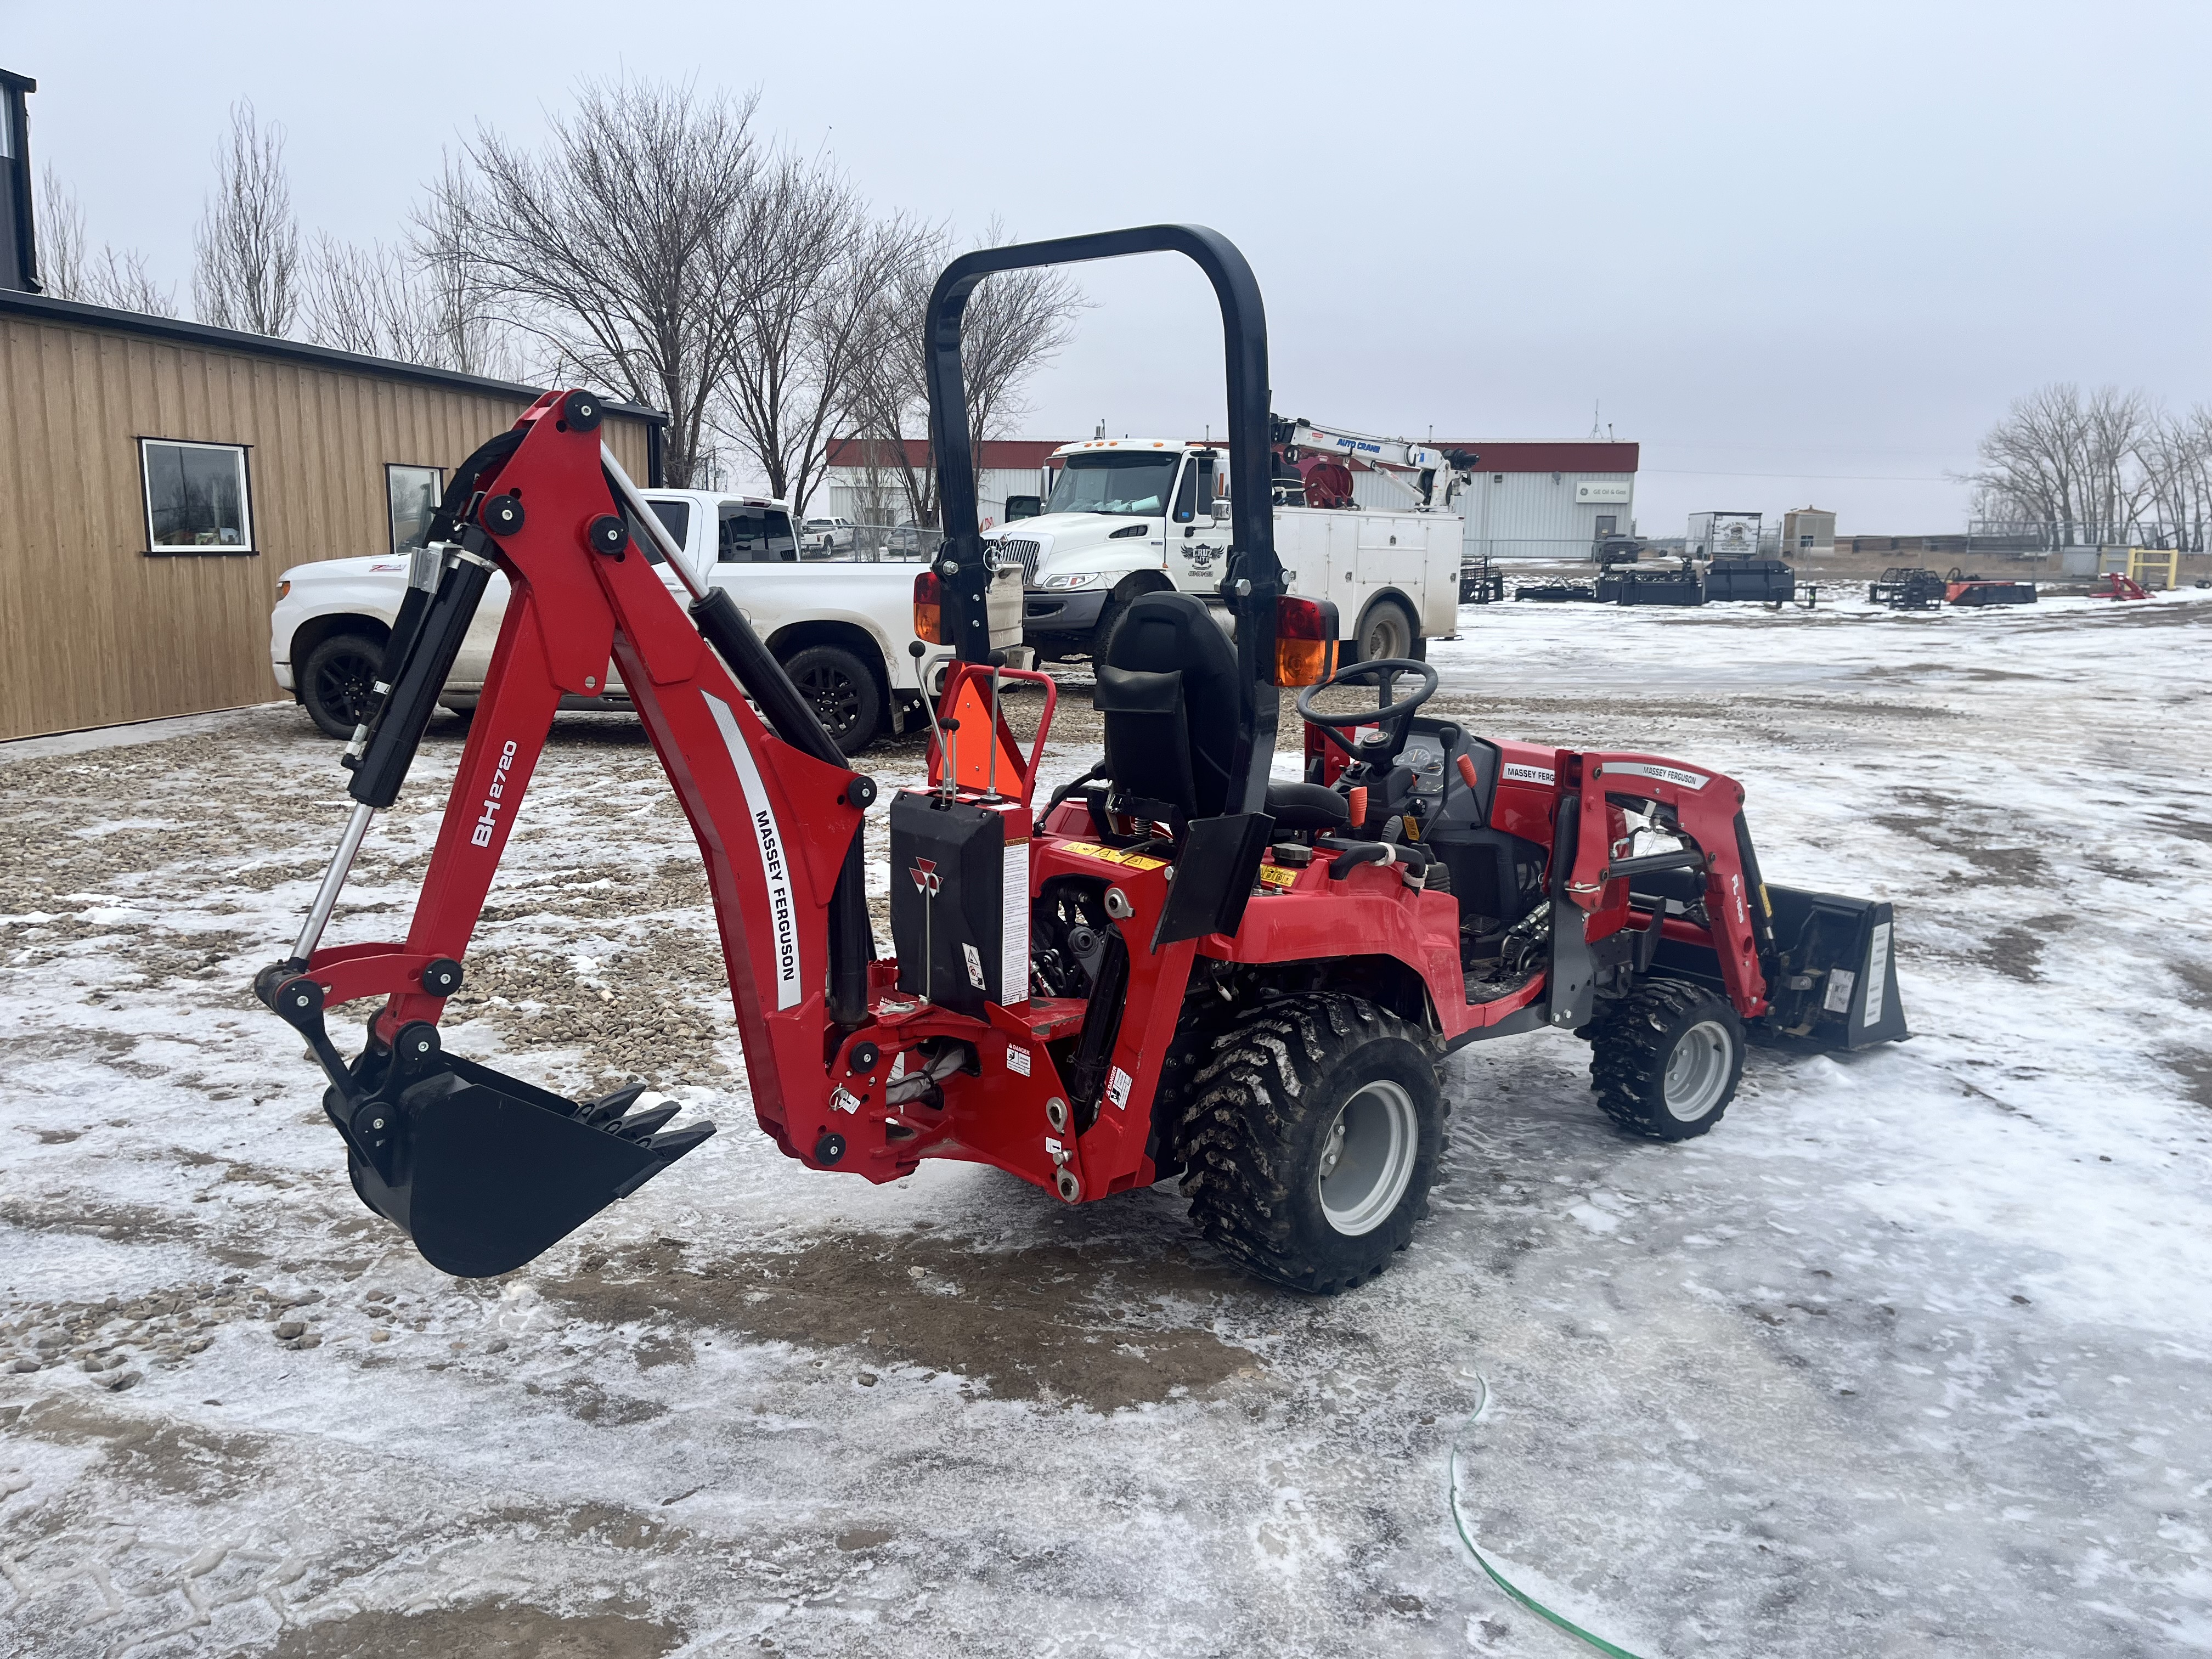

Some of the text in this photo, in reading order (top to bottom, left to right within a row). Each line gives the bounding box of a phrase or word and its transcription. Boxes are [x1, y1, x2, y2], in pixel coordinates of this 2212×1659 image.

[1336, 439, 1381, 453] AUTO CRANE
[1193, 549, 1212, 557] CRUZ
[1508, 768, 1536, 779] MASSEY
[1643, 766, 1696, 785] MASSEY FERGUSON
[471, 741, 517, 848] BH 2720
[1731, 873, 1739, 895] FL
[756, 810, 794, 981] MASSEY FERGUSON
[1013, 1044, 1030, 1056] DANGER
[1107, 1065, 1117, 1090] DANGER
